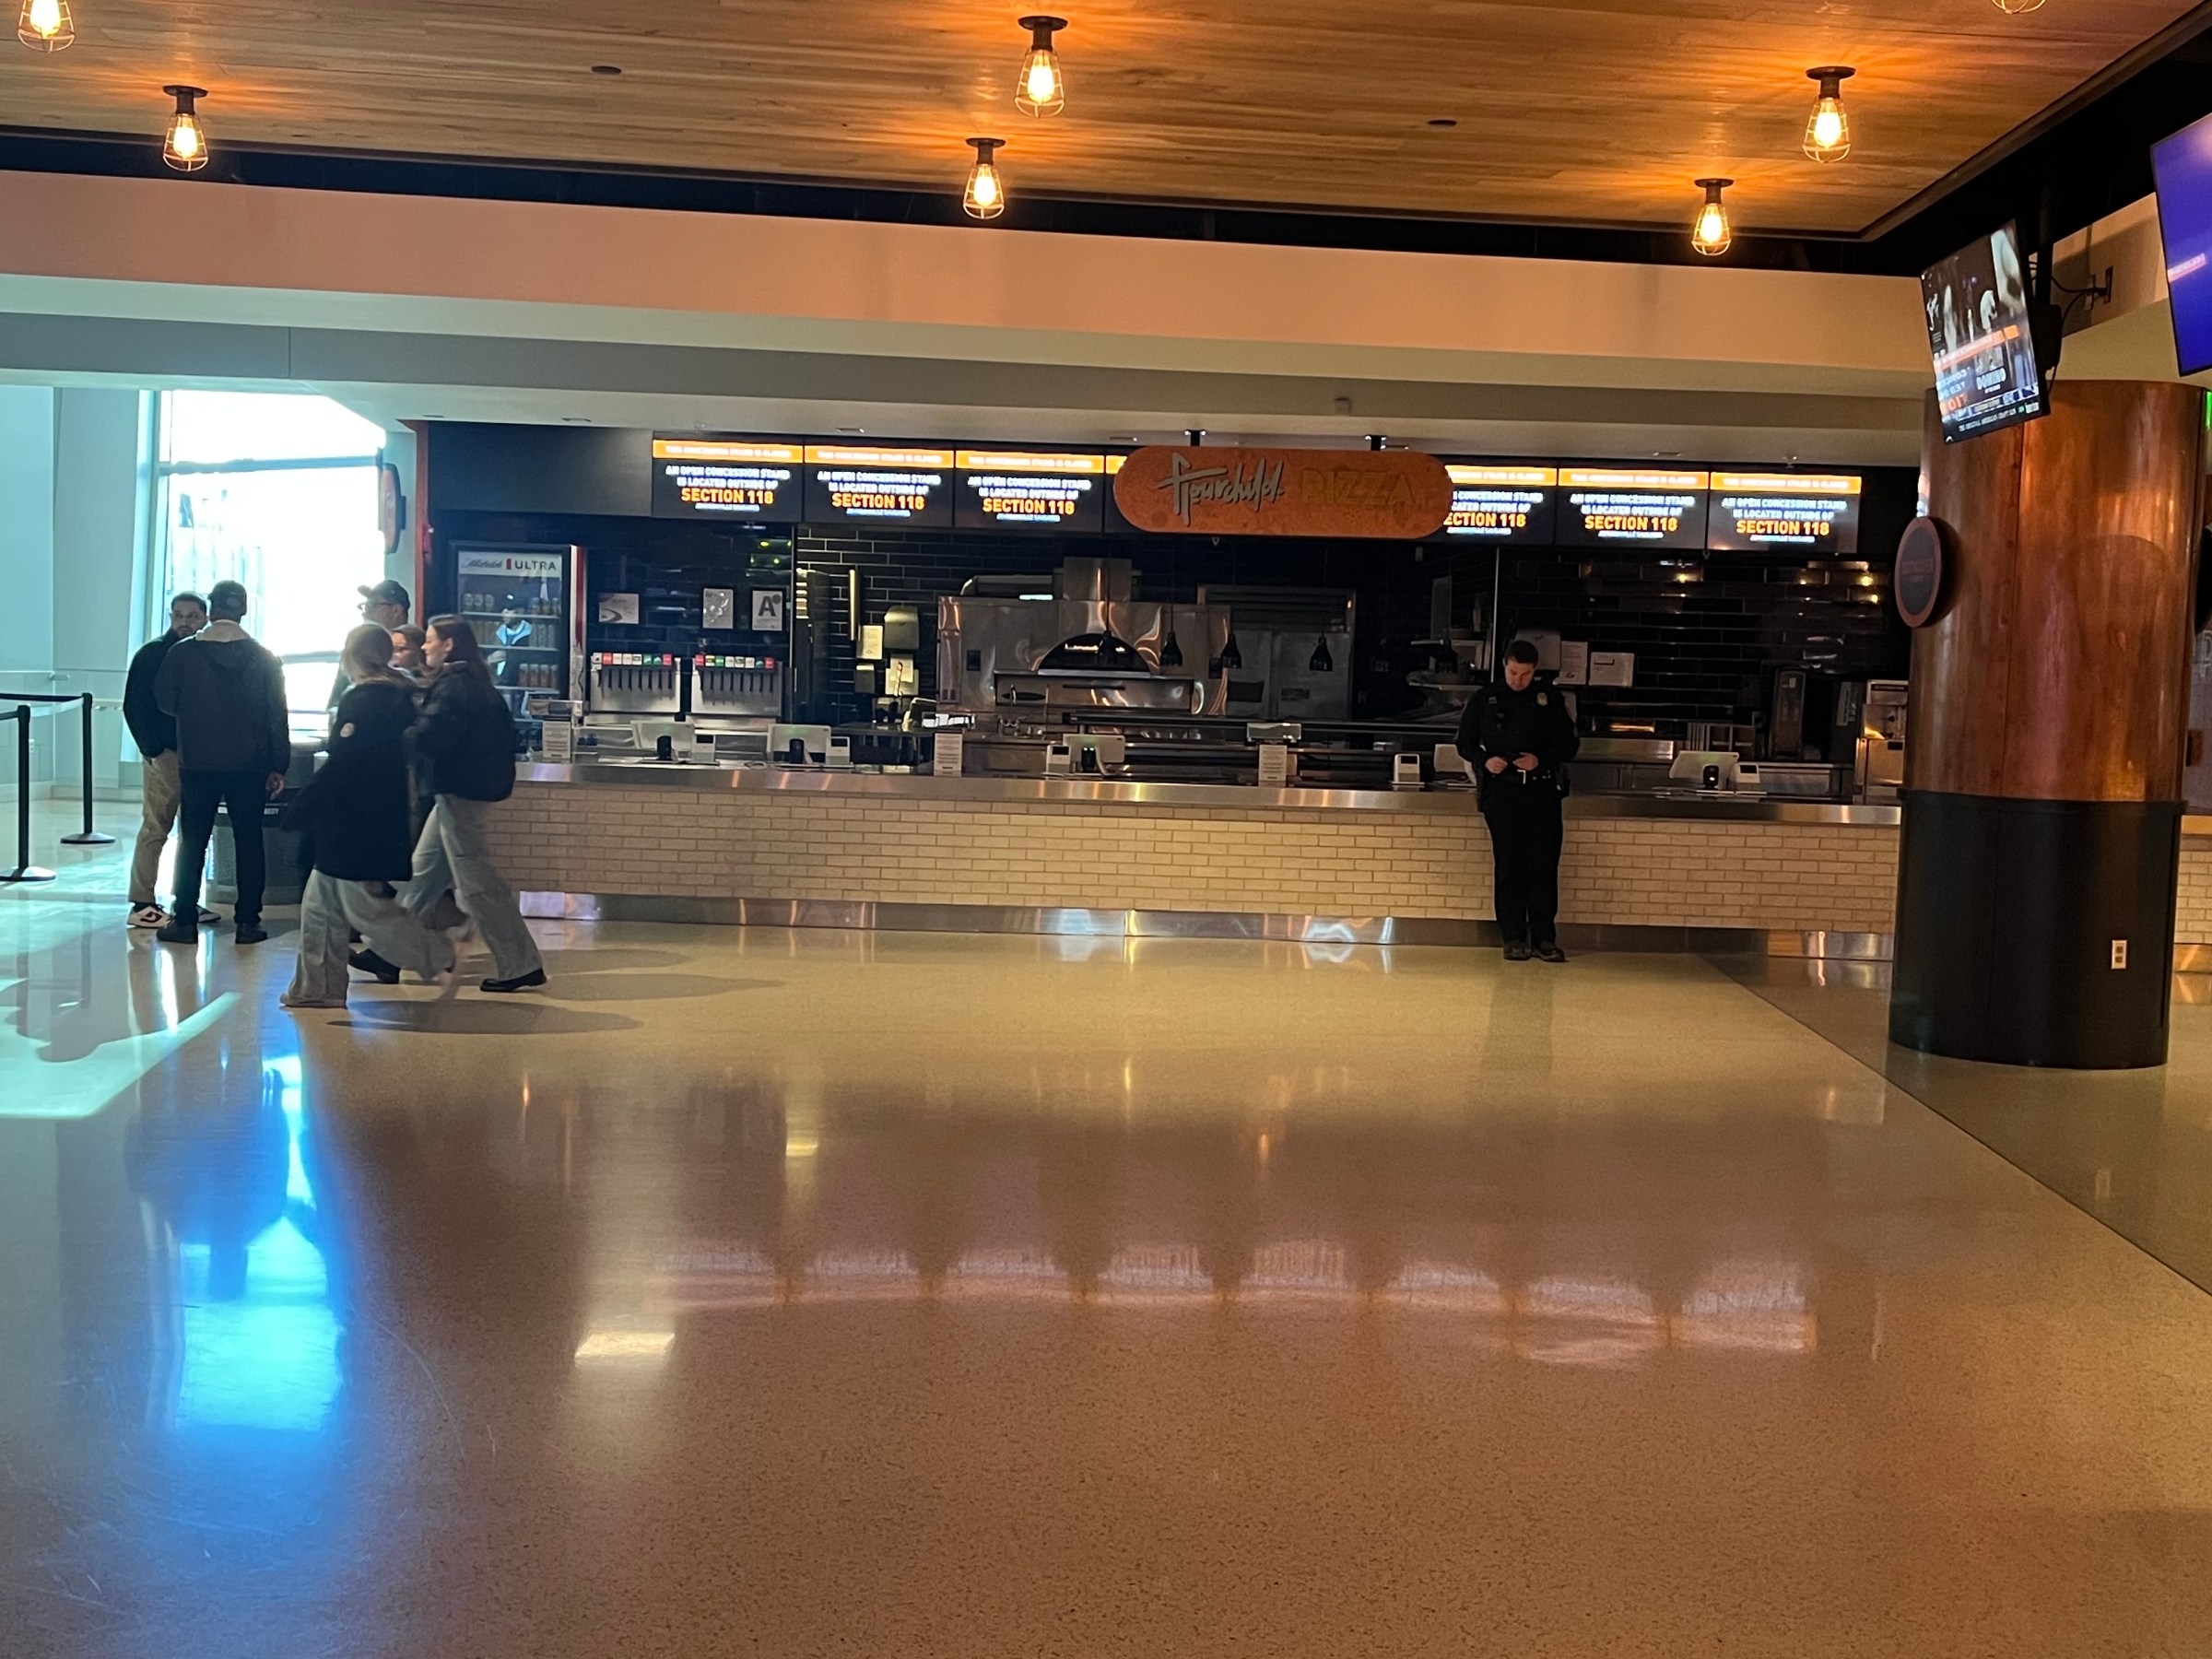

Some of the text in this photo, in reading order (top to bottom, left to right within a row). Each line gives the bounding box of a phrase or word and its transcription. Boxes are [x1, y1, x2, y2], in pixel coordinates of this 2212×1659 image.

[665, 465, 790, 479] AN OPEN CONCESSION STAND
[818, 471, 941, 485] AN OPEN CONCESSION STAND
[677, 477, 778, 489] IS LOCATED OUTSIDE OF
[829, 482, 928, 495] IS LOCATED OUTSIDE OF
[1300, 468, 1416, 506] PIZZA
[681, 488, 774, 504] SECTION 118
[831, 492, 924, 510] SECTION 118
[1571, 494, 1695, 506] AN OPEN CONCESSION STAND
[982, 498, 1075, 514] SECTION 118
[1582, 505, 1683, 516] IS LOCATED OUTSIDE OF
[1722, 498, 1847, 511] AN OPEN CONCESSION STAND
[1443, 512, 1526, 527] ECTION 118
[1733, 509, 1834, 521] IS LOCATED OUTSIDE OF
[1585, 515, 1677, 532] SECTION 118
[1736, 520, 1830, 535] SECTION 118
[515, 559, 557, 571] ULTRA
[758, 595, 776, 617] A
